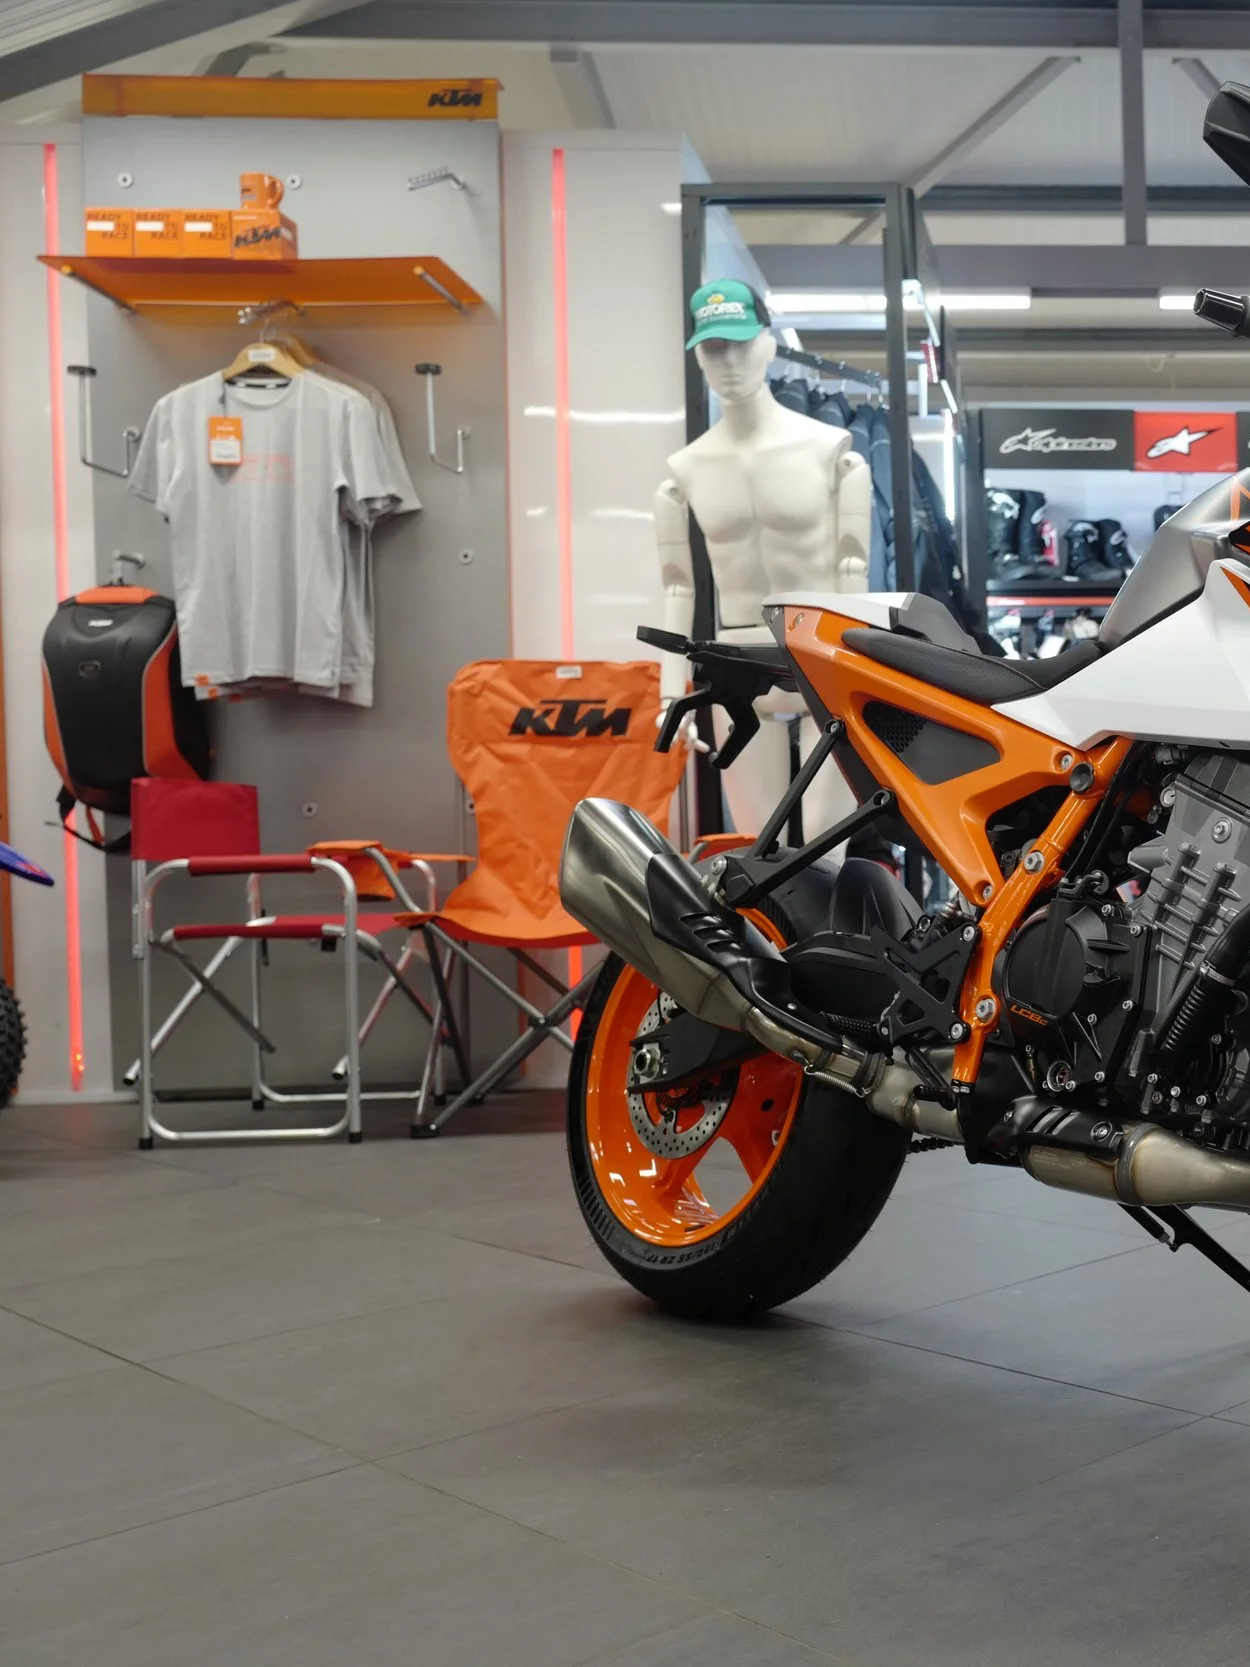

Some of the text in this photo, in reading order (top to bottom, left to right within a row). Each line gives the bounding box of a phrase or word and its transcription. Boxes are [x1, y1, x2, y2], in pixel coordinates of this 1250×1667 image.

[427, 88, 484, 108] KTM
[234, 226, 281, 248] KTM
[508, 699, 632, 736] KTM
